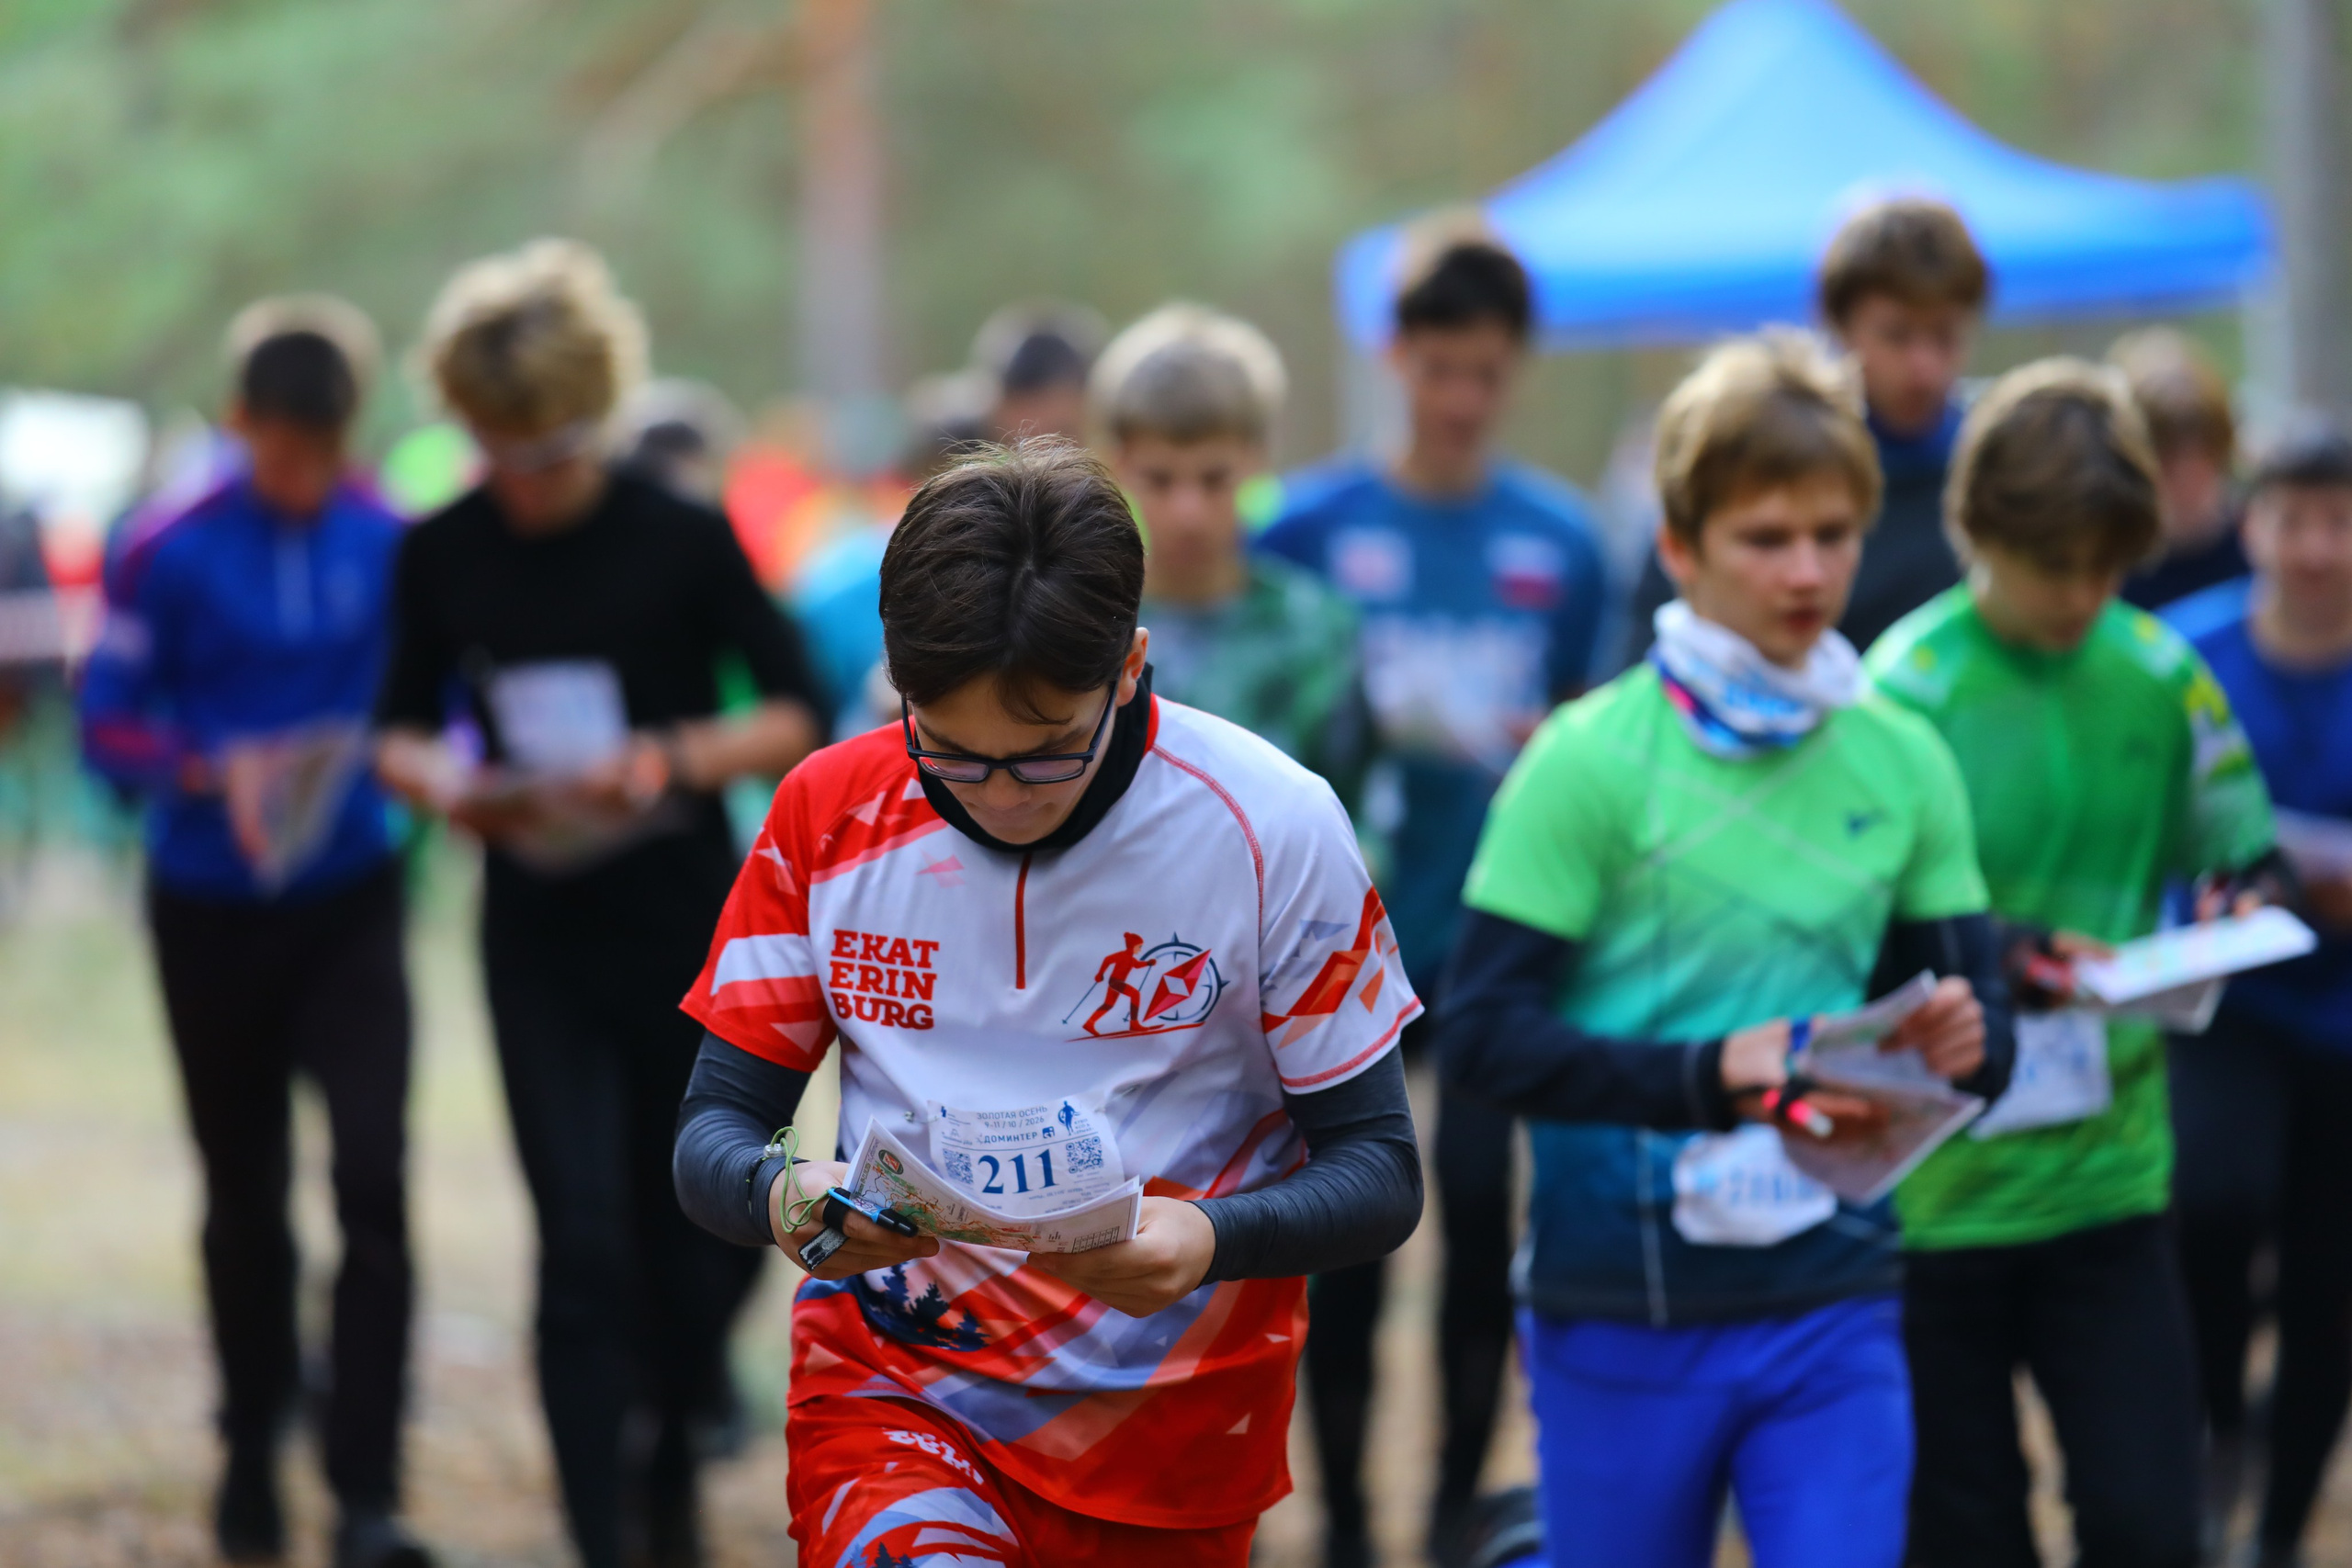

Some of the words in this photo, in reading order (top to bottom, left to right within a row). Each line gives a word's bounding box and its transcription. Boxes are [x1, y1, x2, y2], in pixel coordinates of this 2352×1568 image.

[831, 929, 939, 969] EKAT
[829, 960, 937, 1000] ERIN
[830, 992, 934, 1031] BURG
[977, 1111, 1017, 1121] ЗОЛОТАЯ
[1019, 1105, 1048, 1118] ОСЕНЬ
[984, 1132, 1037, 1144] ДОМИНТЕР
[978, 1148, 1059, 1194] 211
